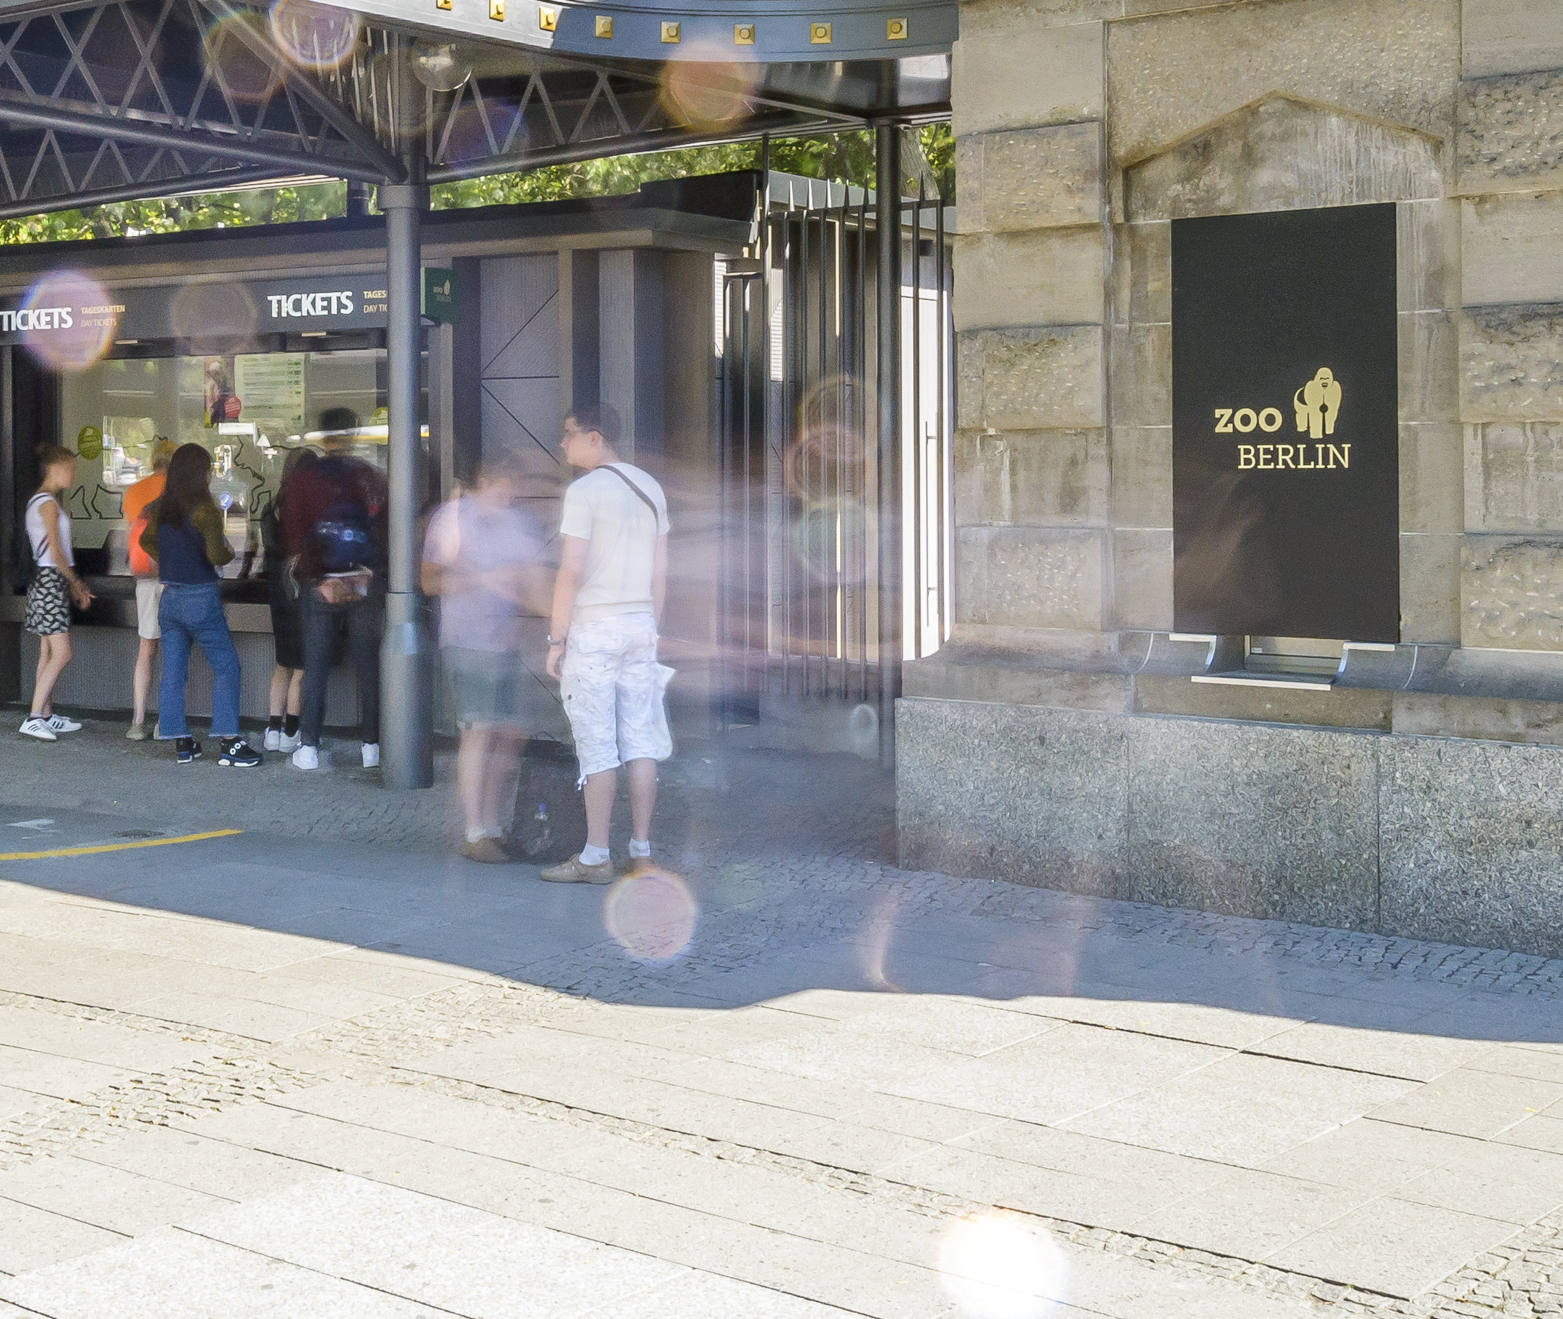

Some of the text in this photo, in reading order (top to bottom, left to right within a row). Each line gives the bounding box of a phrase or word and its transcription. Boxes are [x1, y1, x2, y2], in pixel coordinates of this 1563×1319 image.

[363, 290, 387, 299] TAGES
[81, 304, 126, 315] TAGESKARTEN
[267, 291, 354, 318] TICKETS
[363, 304, 377, 314] DAY
[0, 307, 73, 331] TICKETS
[81, 317, 117, 328] DAY TICKETS
[1214, 407, 1283, 433] ZOO
[1237, 443, 1352, 469] BERLIN
